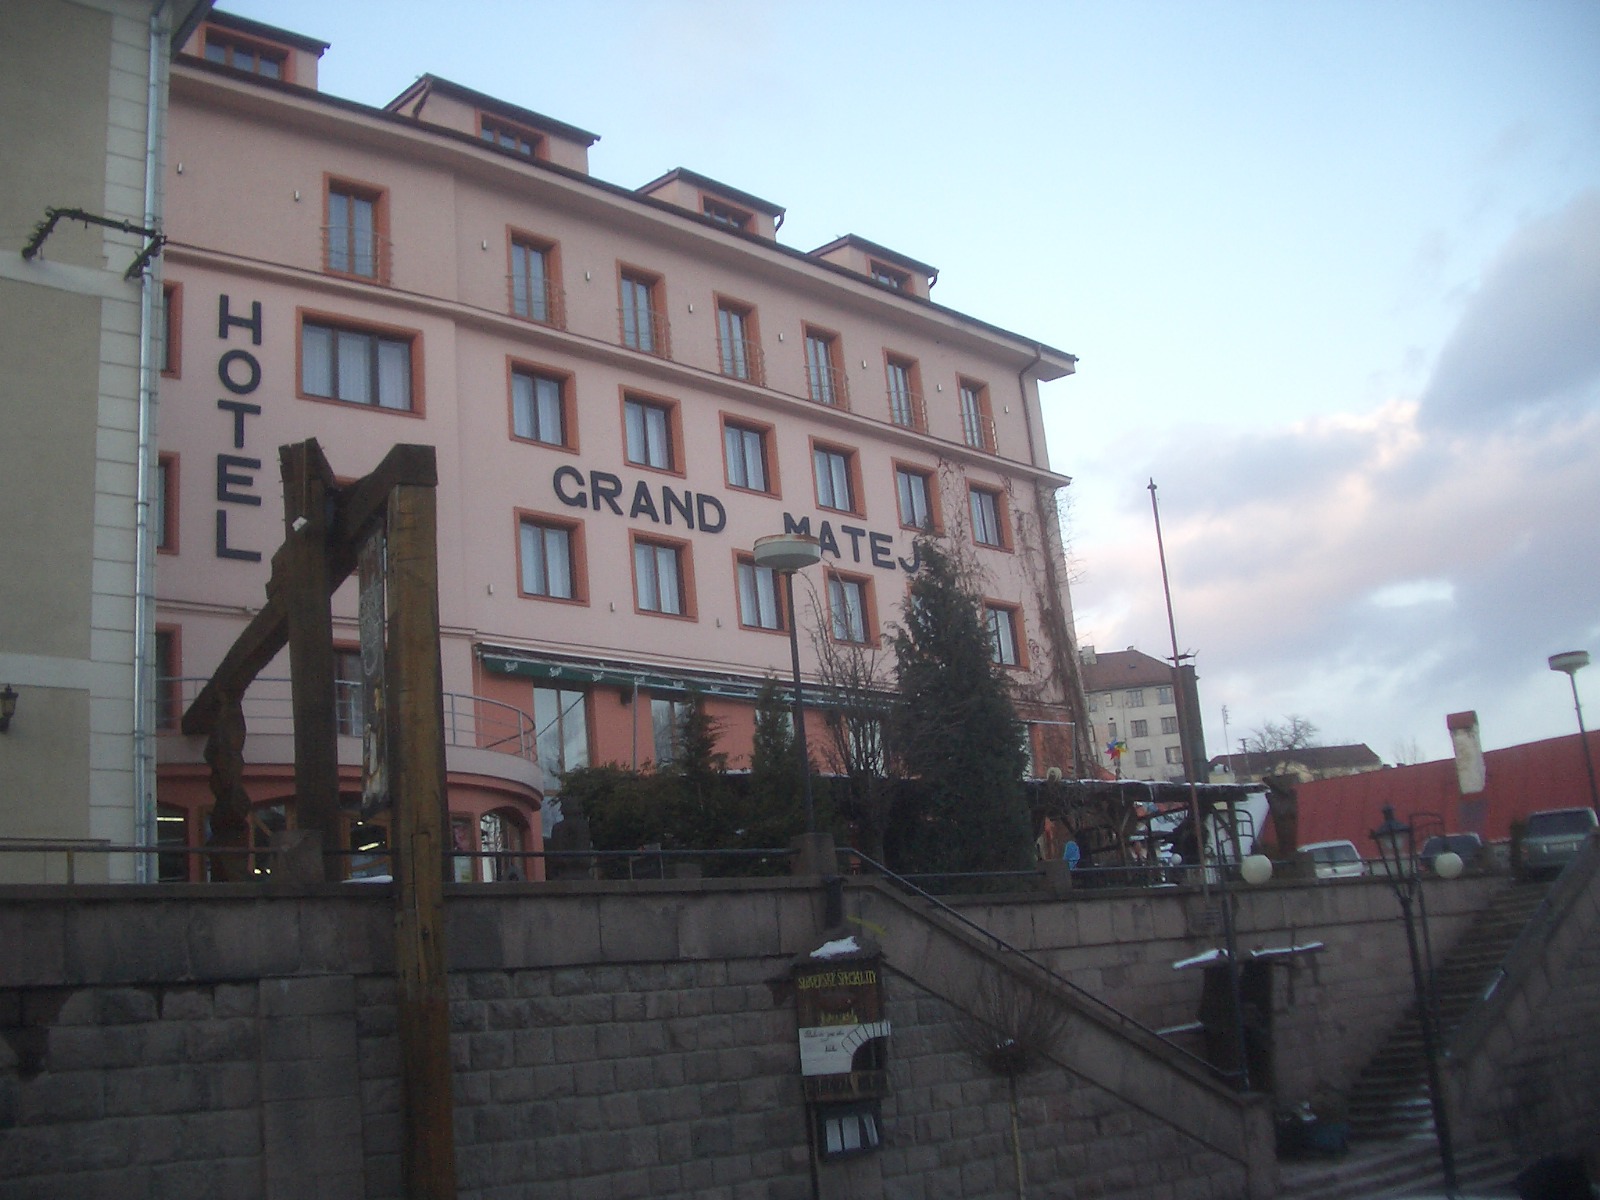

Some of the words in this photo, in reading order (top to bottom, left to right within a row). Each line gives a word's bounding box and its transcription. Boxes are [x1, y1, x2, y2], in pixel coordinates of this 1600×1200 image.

[217, 294, 262, 562] HOTEL
[552, 465, 726, 534] GRAND
[783, 512, 921, 574] MATEJ
